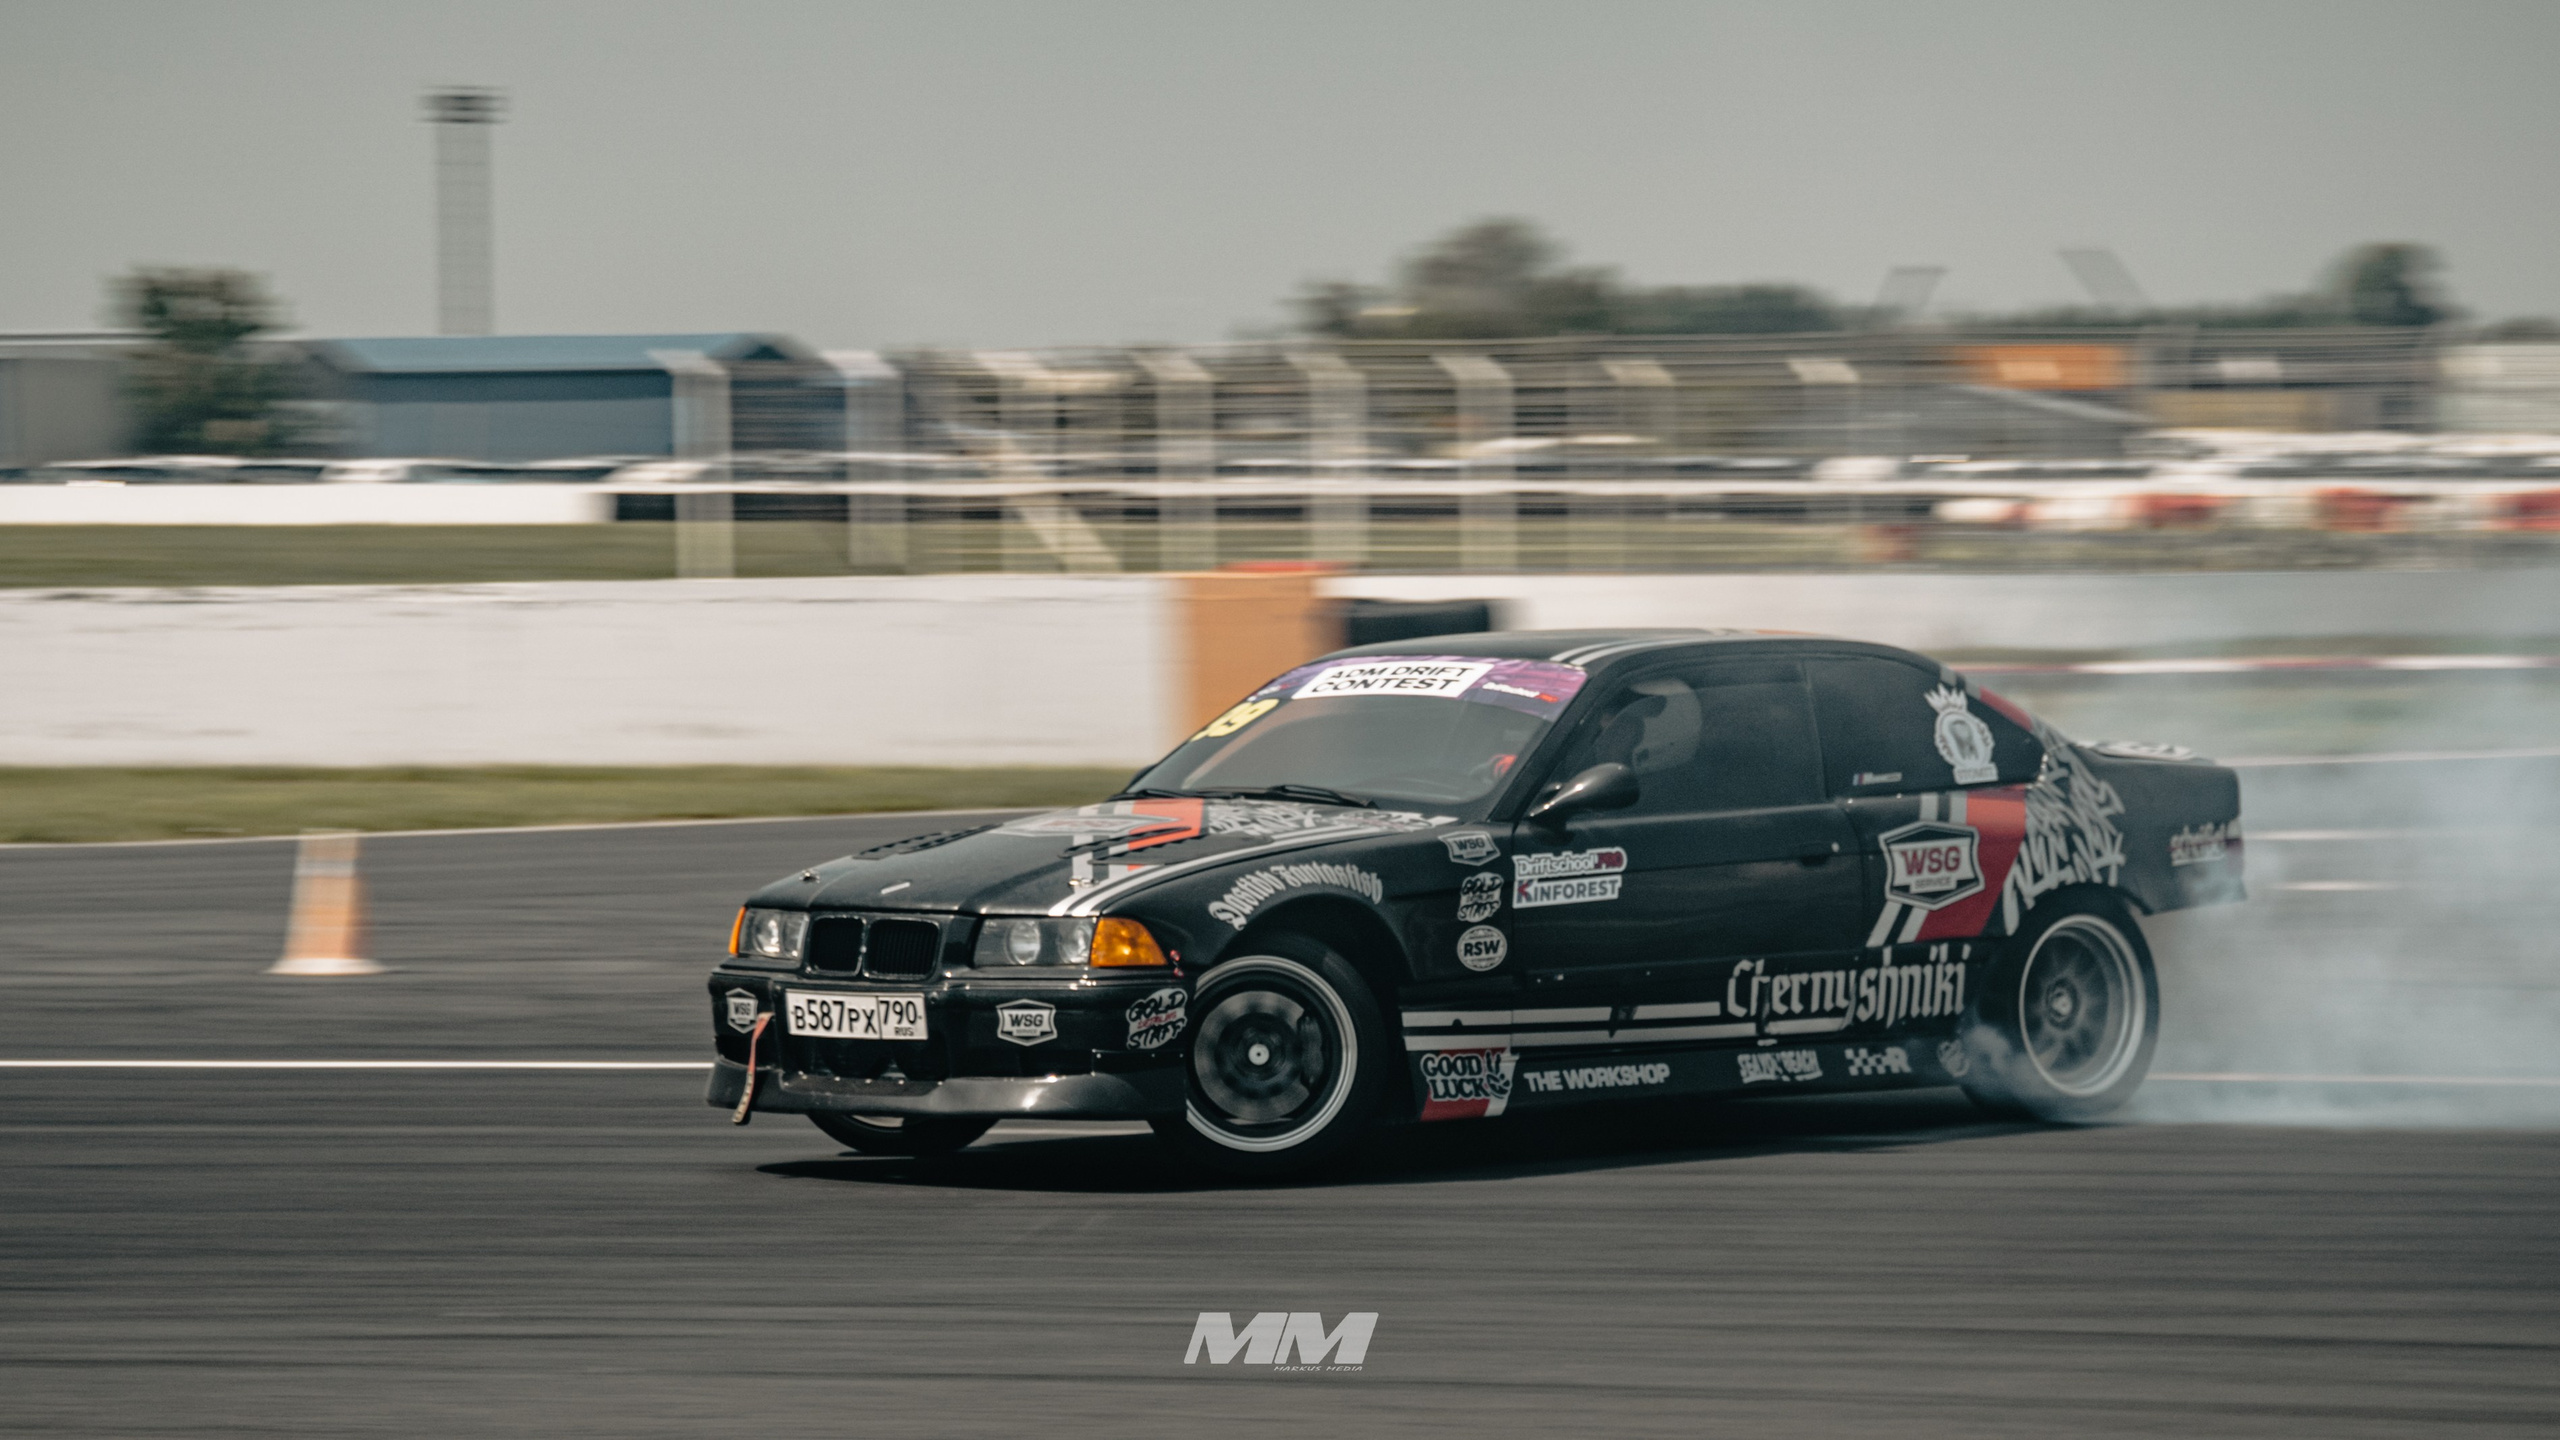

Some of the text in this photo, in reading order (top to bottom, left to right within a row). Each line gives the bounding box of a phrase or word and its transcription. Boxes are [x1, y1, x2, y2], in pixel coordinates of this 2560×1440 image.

[1330, 665, 1474, 679] ADM DRIFT
[1311, 678, 1460, 693] CONTEST
[1453, 837, 1486, 851] WSG
[1901, 845, 1961, 875] WSG
[1516, 878, 1619, 904] KINFOREST
[1463, 939, 1500, 957] RSW
[879, 1000, 918, 1025] 790
[1129, 990, 1186, 1022] GOLD
[893, 1026, 915, 1037] RUS
[1007, 1013, 1045, 1028] WSG
[1128, 1017, 1186, 1050] STAFF
[1421, 1056, 1483, 1077] GOOD
[1523, 1063, 1671, 1092] THE WORKSHOP
[1428, 1077, 1491, 1100] LUCK
